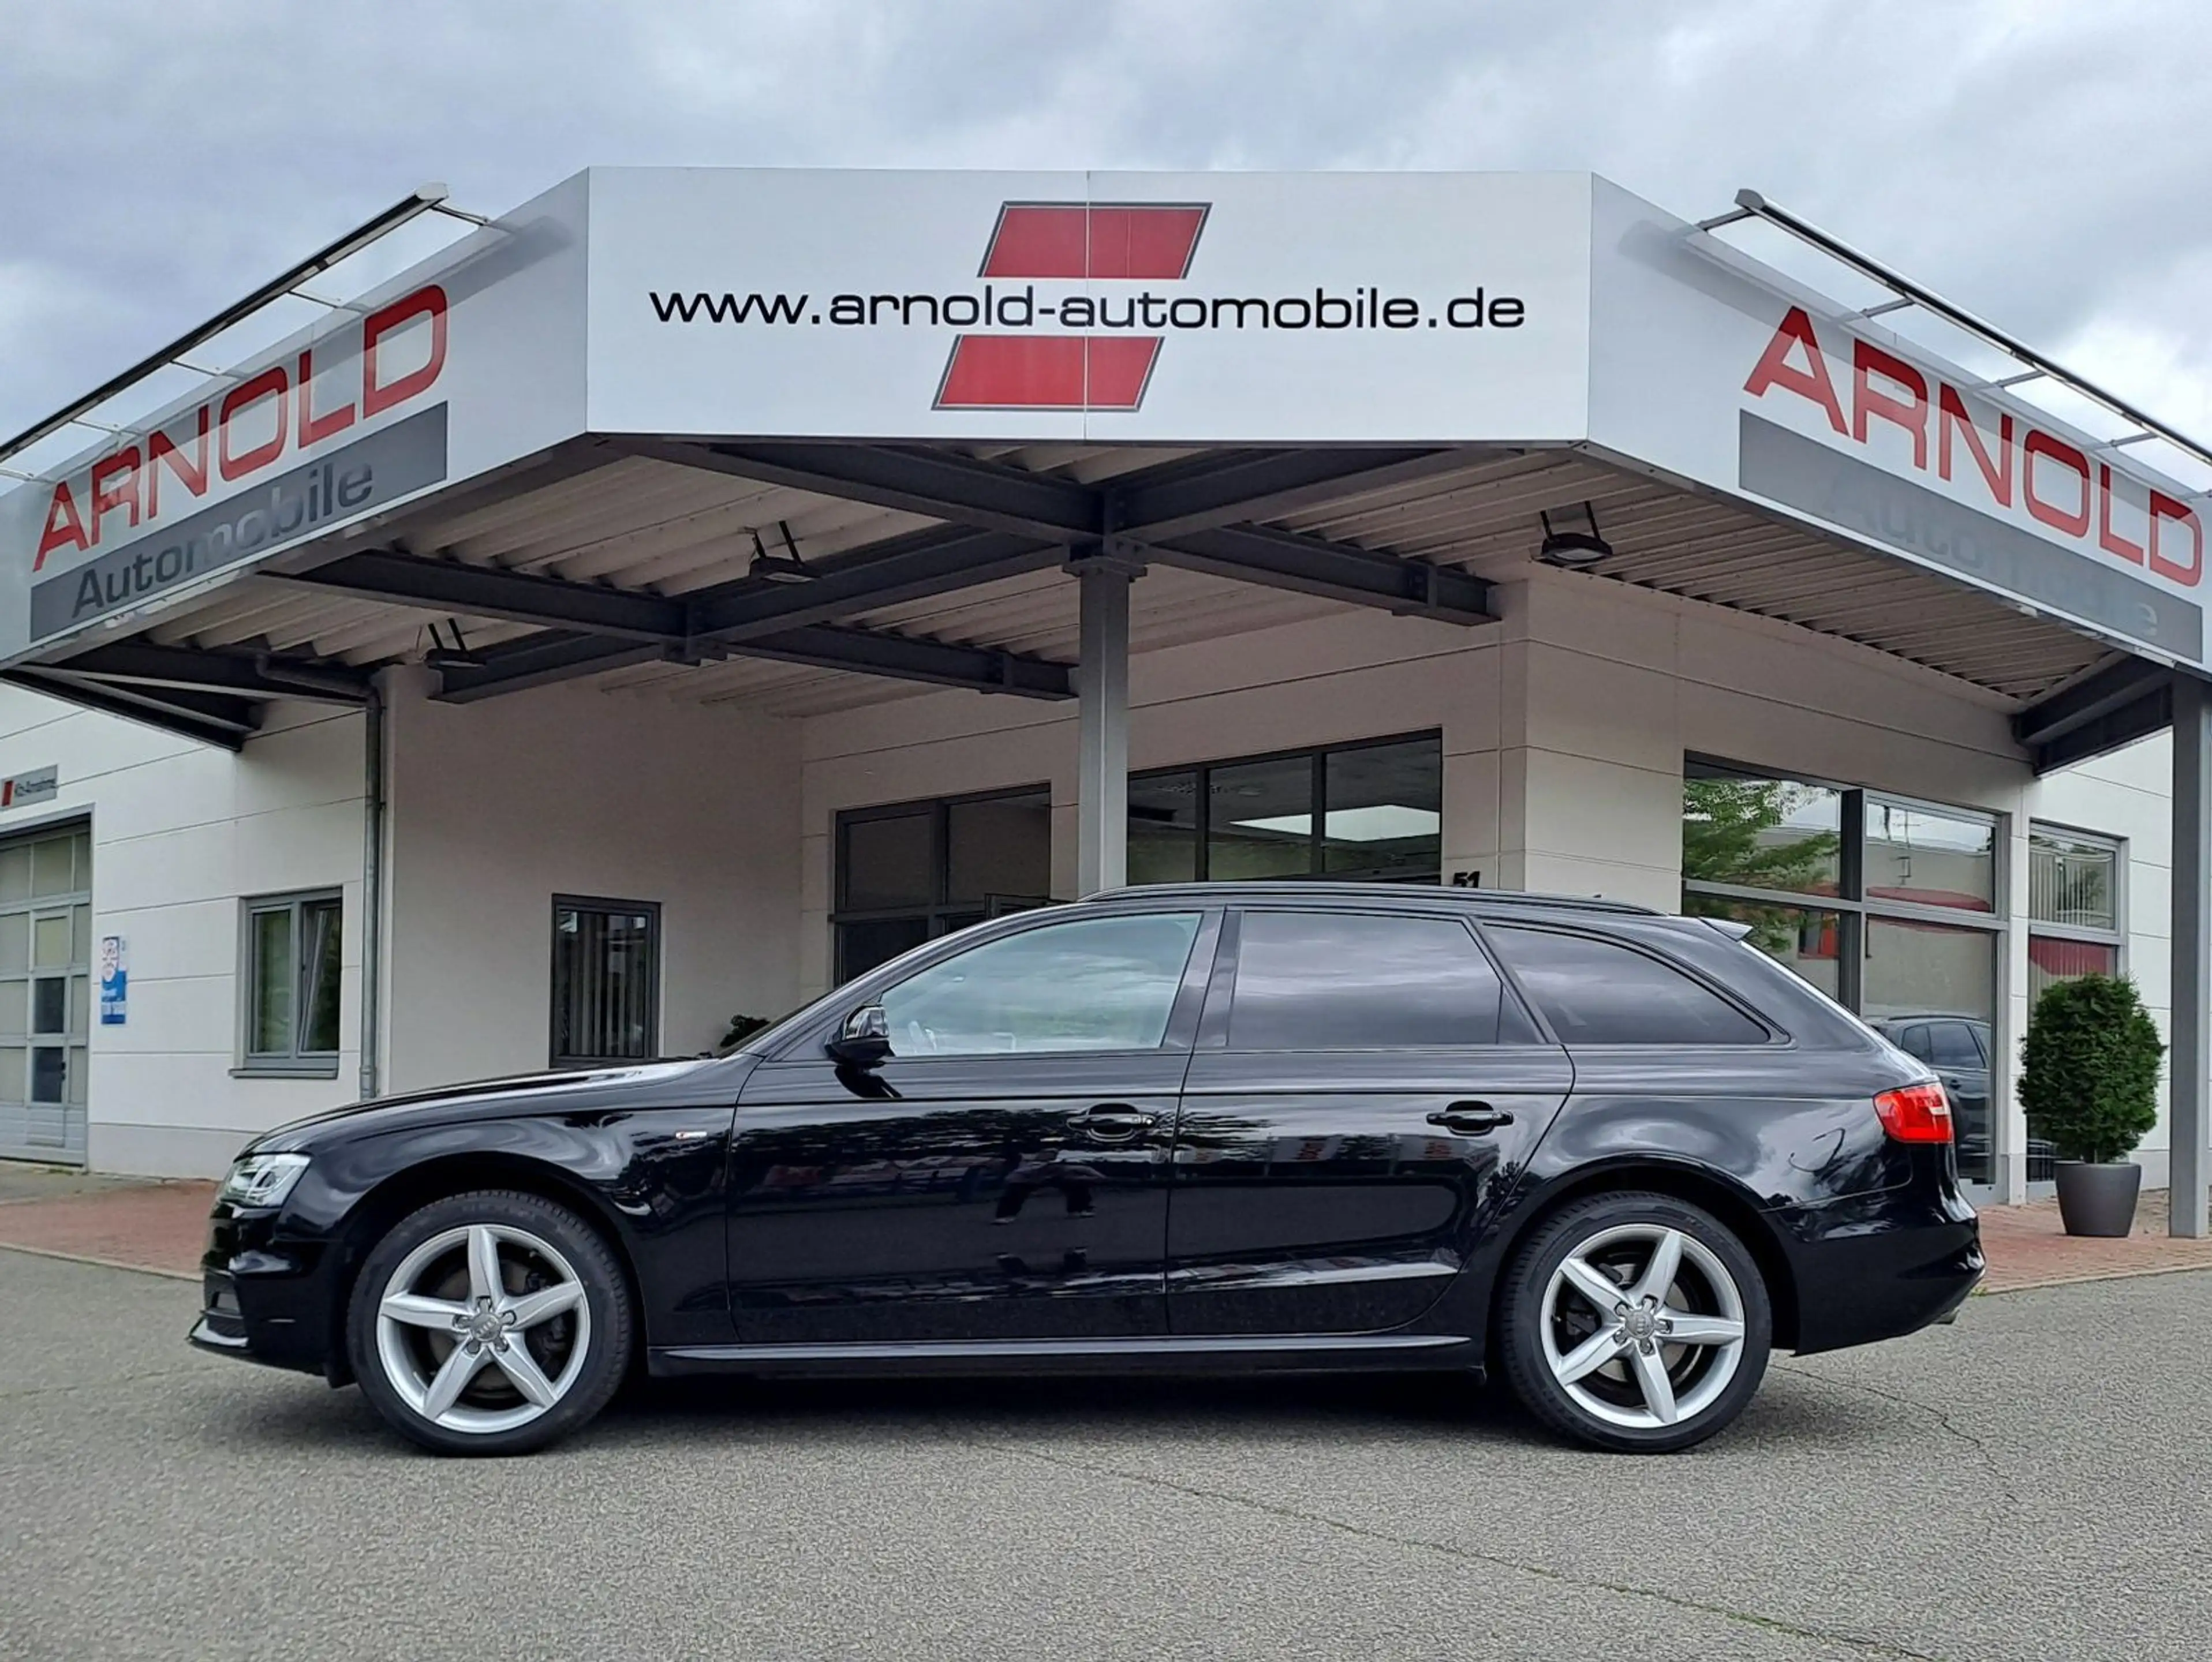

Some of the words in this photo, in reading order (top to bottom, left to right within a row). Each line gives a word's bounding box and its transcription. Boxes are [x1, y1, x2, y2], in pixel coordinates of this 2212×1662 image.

[649, 285, 1524, 328] www.arnold-automobile.de
[33, 284, 448, 572] ARNOLD
[1743, 305, 2202, 587] ARNOLD
[72, 462, 372, 619] Automobile
